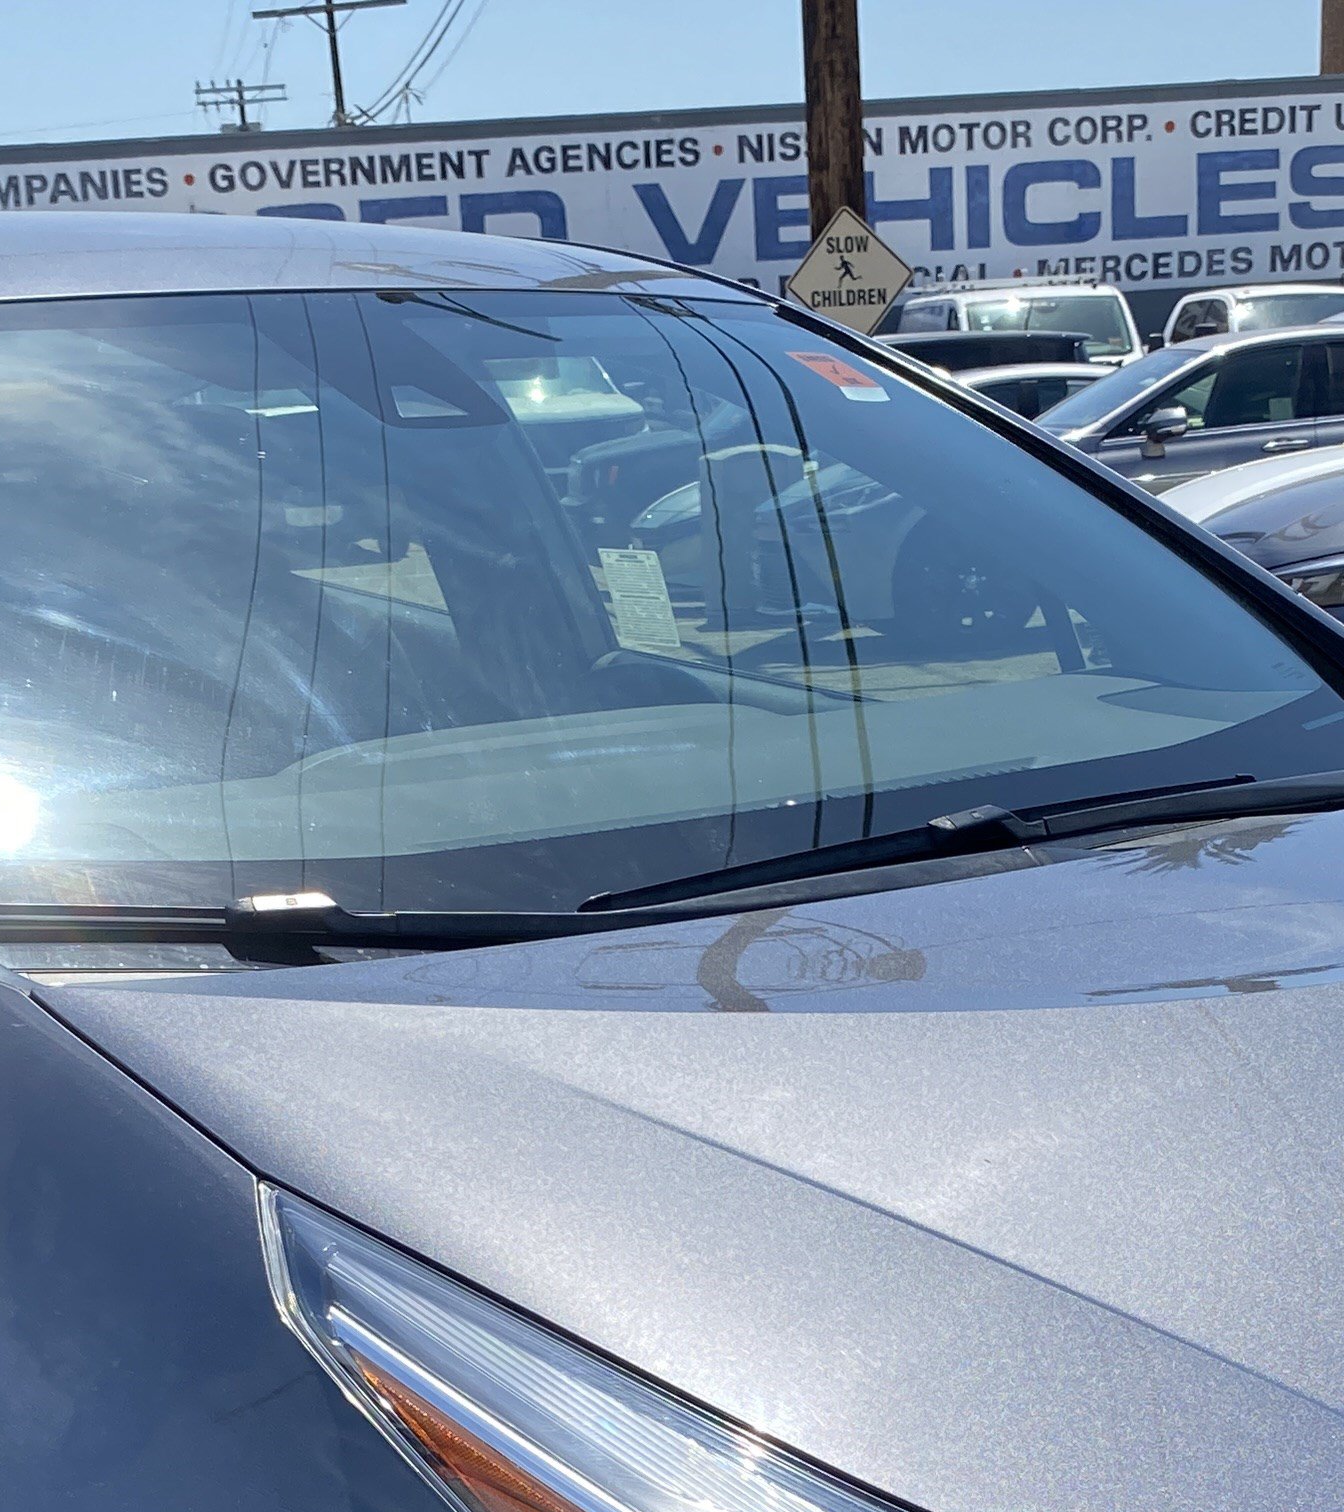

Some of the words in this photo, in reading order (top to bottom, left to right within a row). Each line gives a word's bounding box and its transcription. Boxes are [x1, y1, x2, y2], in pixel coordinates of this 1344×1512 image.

[208, 148, 492, 194] GOVERNMENT
[505, 137, 701, 179] AGENCIES
[737, 127, 883, 164] NISN
[899, 116, 1039, 156] MOTOR
[1047, 112, 1154, 147] CORP.
[1189, 103, 1321, 139] CREDIT
[826, 234, 870, 255] SLOW
[1036, 246, 1254, 283] MERCEDES
[811, 287, 887, 309] CHILDREN
